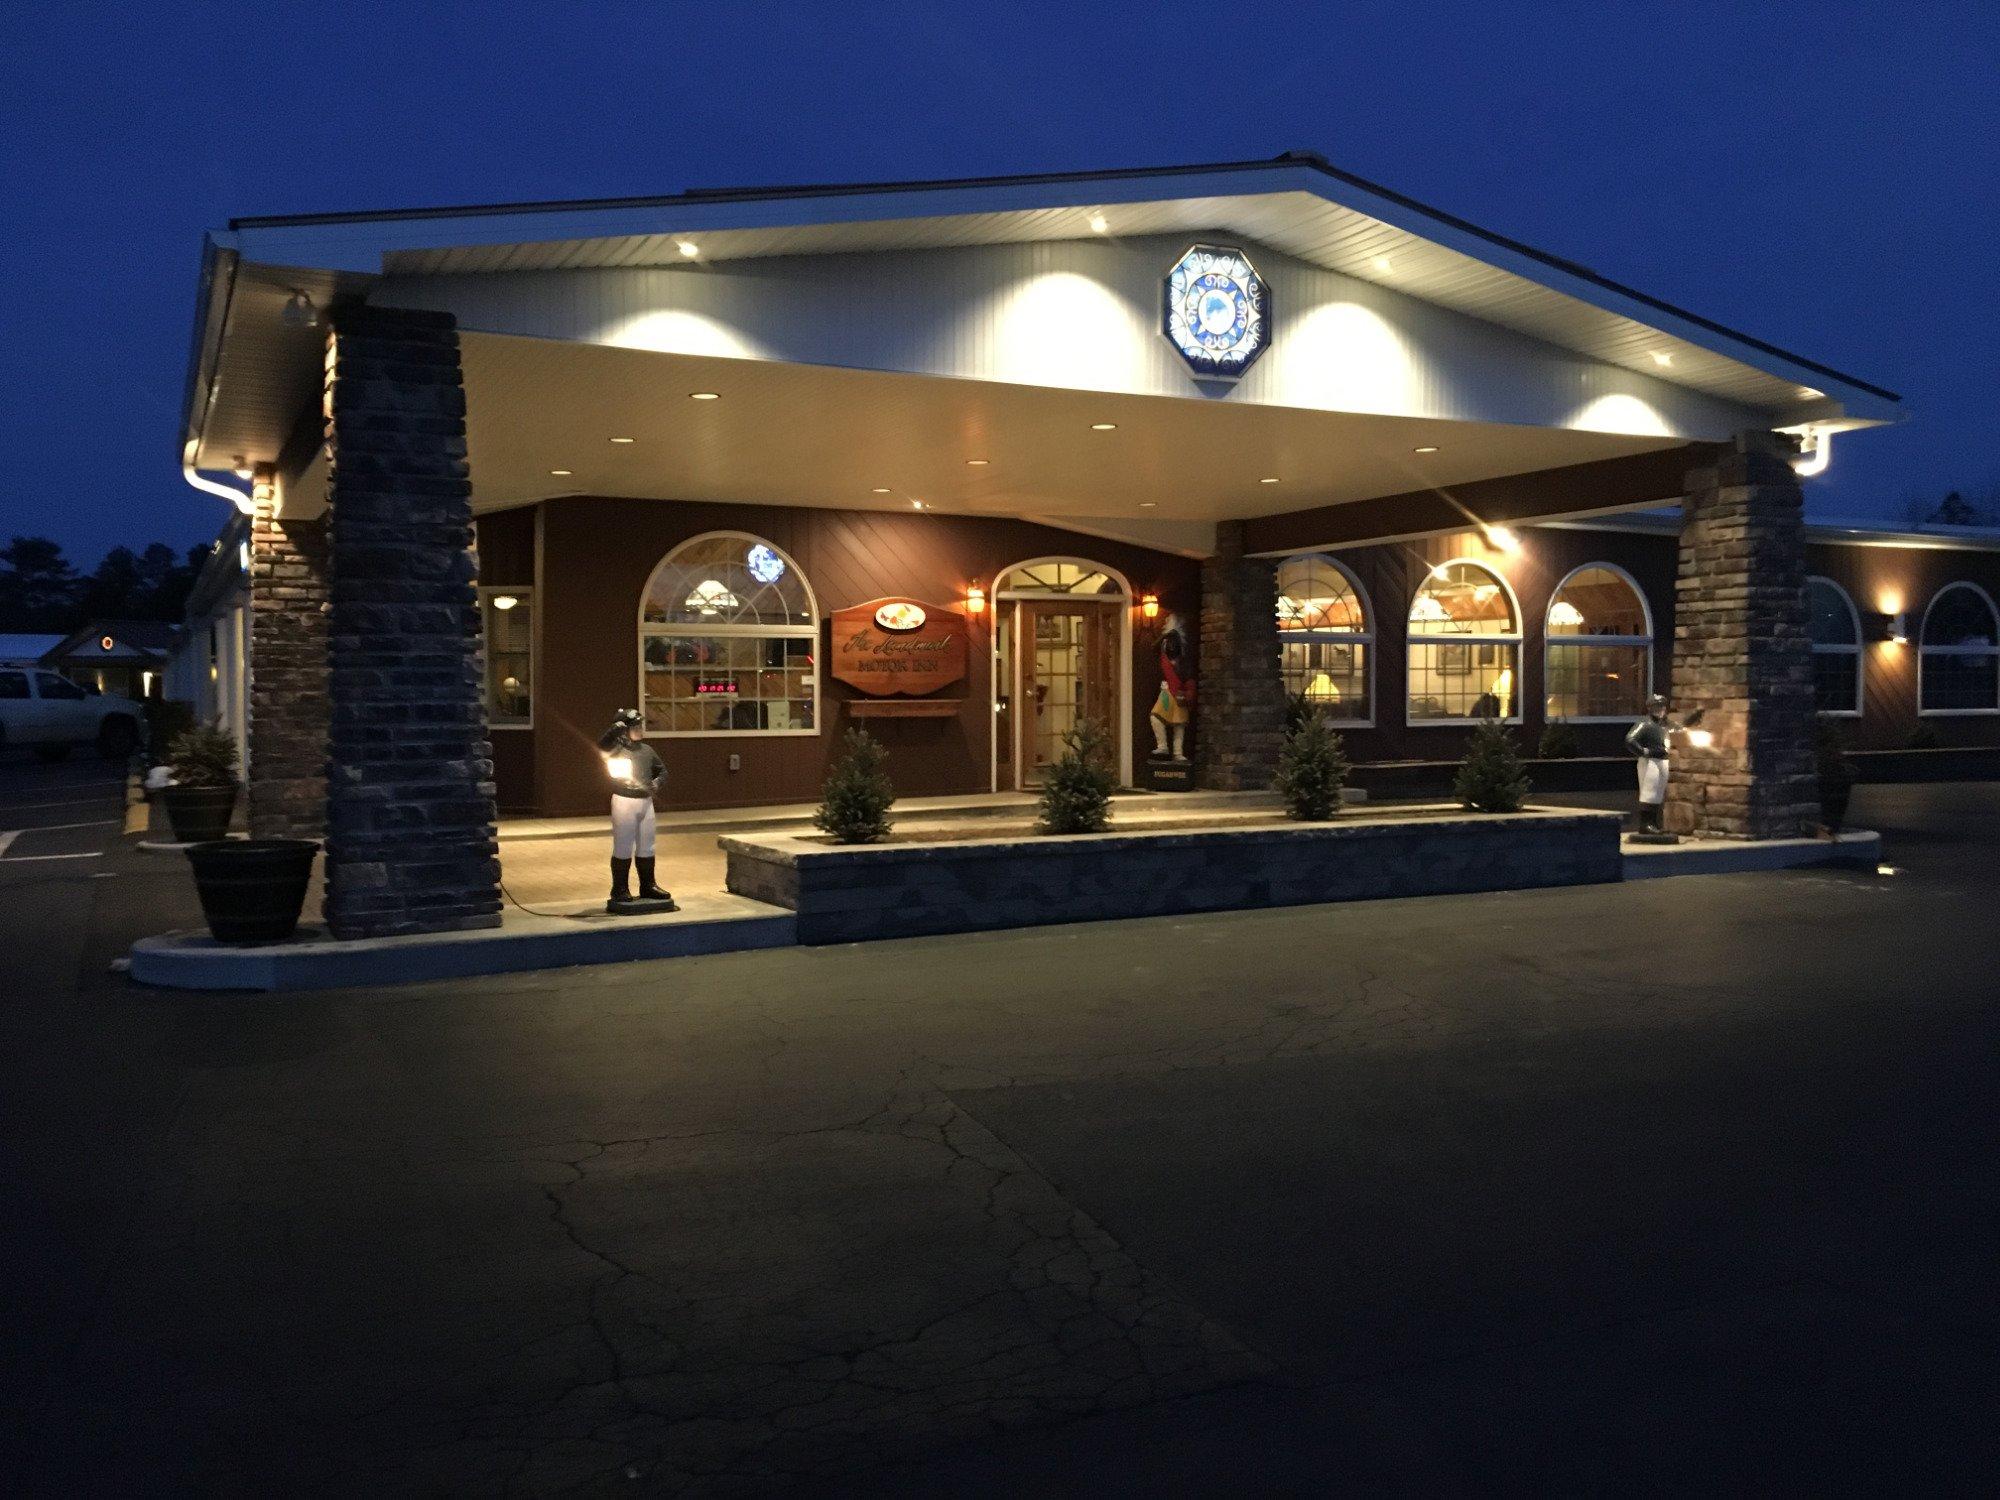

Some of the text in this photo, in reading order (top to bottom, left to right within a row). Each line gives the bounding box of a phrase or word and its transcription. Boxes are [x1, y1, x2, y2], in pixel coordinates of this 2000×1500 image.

[843, 629, 952, 655] The Landmark
[858, 659, 938, 673] MOTOR INN
